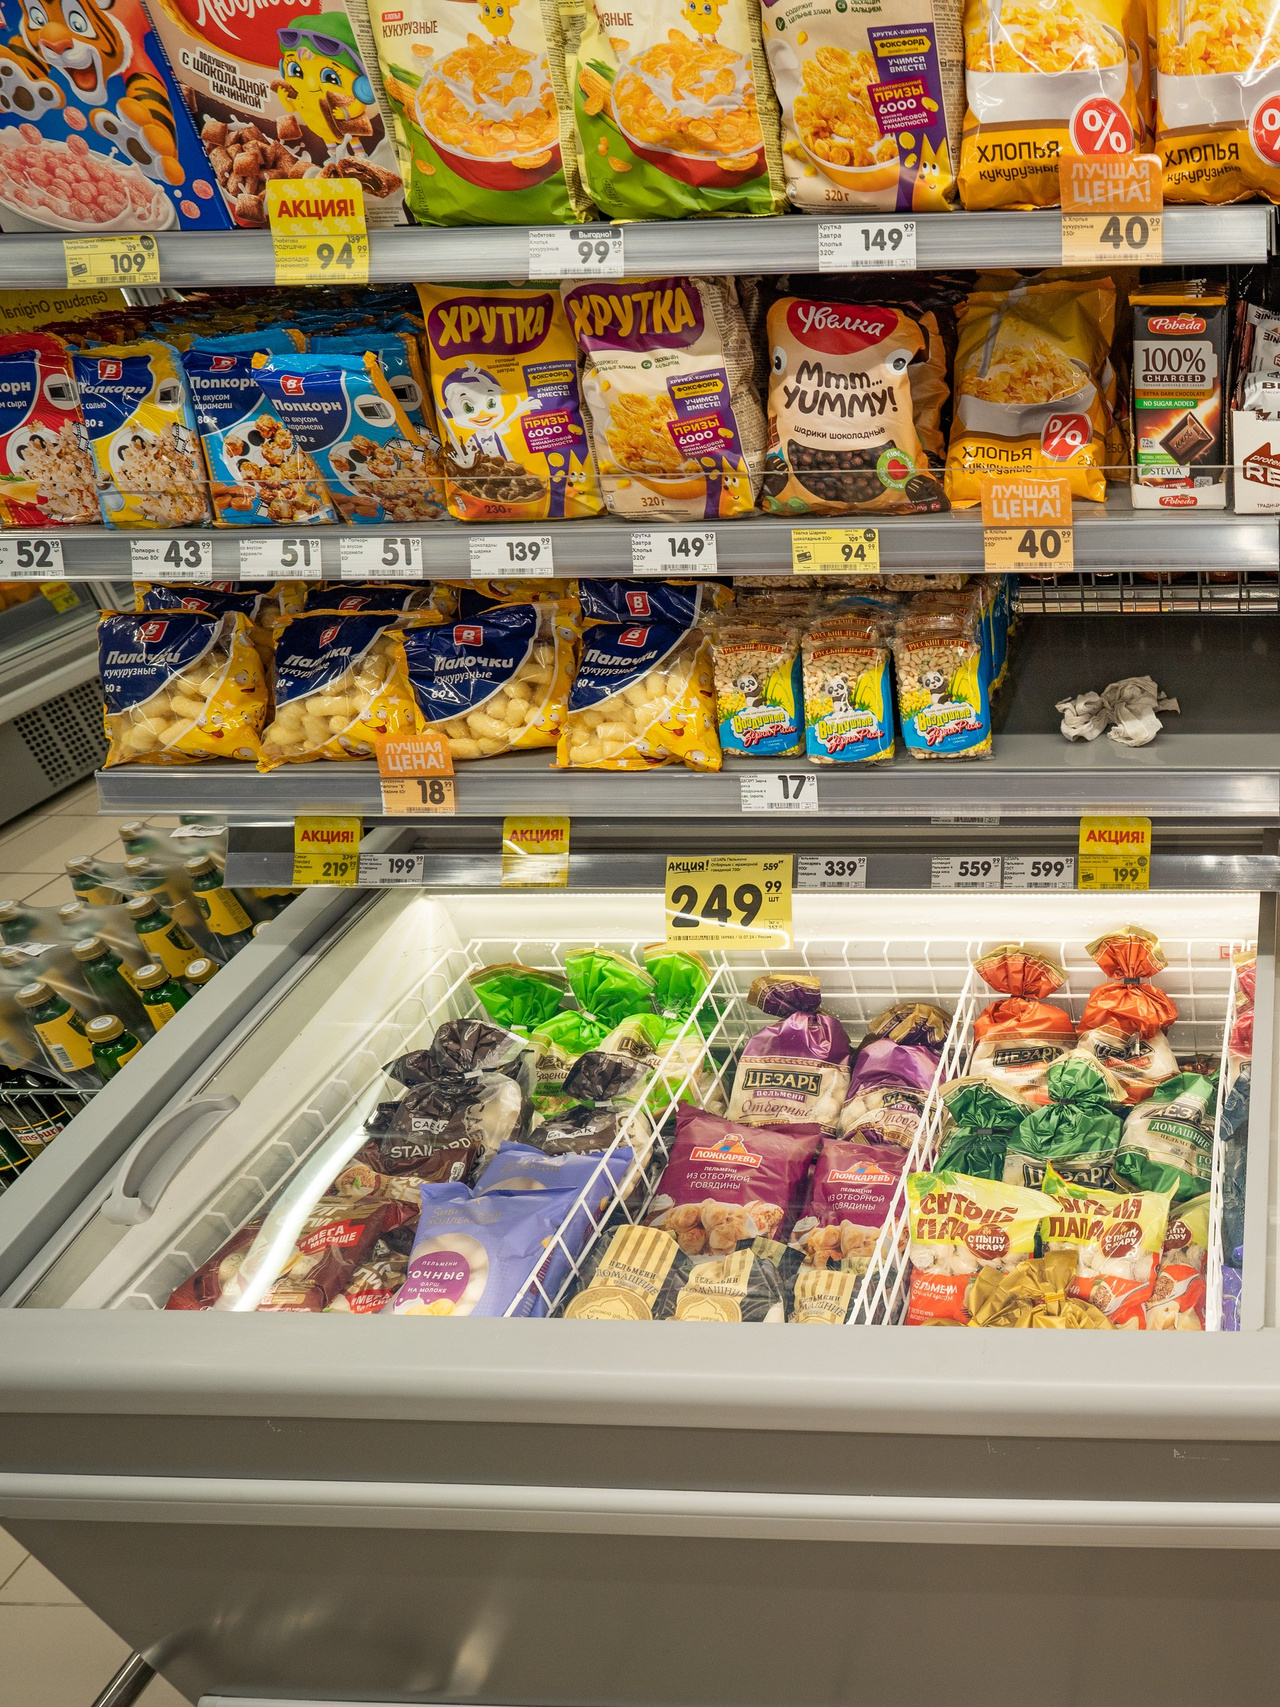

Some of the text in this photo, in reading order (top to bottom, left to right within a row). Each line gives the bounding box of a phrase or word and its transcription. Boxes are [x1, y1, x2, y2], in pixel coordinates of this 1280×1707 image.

[382, 20, 438, 38] КУКУРУЗНЫЕ
[879, 38, 925, 49] ФОКСФОРД
[198, 50, 238, 76] ПОДУШЕЧКИ
[887, 55, 925, 66] УЧИМСЯ
[890, 63, 927, 73] ВМЕСТЕ!
[182, 52, 270, 97] С ШОКОЛАДНОЙ
[212, 80, 262, 110] НАЧИНКОЙ
[874, 86, 924, 101] ПРИЗЫ
[878, 99, 917, 114] 6000
[882, 112, 928, 125] ФИНАНСОВОЙ
[883, 118, 929, 132] ГРАМОТНОСТИ
[977, 140, 1059, 163] ХЛОПЬЯ
[979, 163, 1059, 183] кукурузные
[1071, 163, 1149, 179] ЛУЧШАЯ
[1167, 165, 1241, 184] кукурузные
[1073, 181, 1151, 202] ЦЕНА!
[276, 198, 356, 220] АКЦИЯ!
[578, 230, 613, 239] Выгодно!
[861, 229, 902, 251] 149
[1100, 216, 1160, 249] 40 99
[317, 244, 352, 270] 94
[577, 240, 609, 264] 99
[110, 254, 146, 273] 109
[569, 287, 696, 342] ХРУТКА
[797, 305, 885, 337] Увелка
[437, 305, 546, 346] ХРУТКА
[1152, 318, 1202, 331] Pobeda
[1142, 347, 1206, 373] 100%
[797, 360, 883, 390] Mmm...
[1143, 374, 1205, 382] CHARGED
[77, 382, 146, 396] Попкорн
[783, 384, 897, 418] YUMMY!
[288, 424, 323, 433] карамели
[794, 425, 886, 439] шарики шоколадные
[1150, 467, 1182, 476] STEVIA
[281, 540, 309, 567] 51
[841, 545, 865, 562] 94
[1018, 530, 1061, 559] 40
[16, 541, 49, 568] 52
[164, 541, 201, 568] 43
[105, 651, 181, 664] Палочки
[918, 708, 972, 729] Воздушные
[417, 780, 445, 805] 18
[778, 775, 806, 799] 17
[301, 829, 354, 843] АКЦИЯ!
[322, 862, 348, 877] 219
[389, 859, 415, 874] 199
[763, 863, 778, 871] 559
[824, 860, 857, 877] 339
[958, 860, 991, 877] 559
[1030, 861, 1064, 877] 599
[670, 881, 782, 928] 249 99
[746, 1072, 819, 1091] ЦЕЗАРЬ
[756, 1090, 805, 1101] пельмени
[741, 1099, 812, 1118] Отборные
[696, 1151, 760, 1166] ЛОЖКАРЕВЪ
[687, 1172, 750, 1182] ИЗ ОТБОРНОЙ
[691, 1181, 741, 1189] ГОВЯДИНЫ
[310, 1231, 357, 1249] МЯСИЩЕ
[596, 1269, 658, 1296] ДОМАШНИЕ
